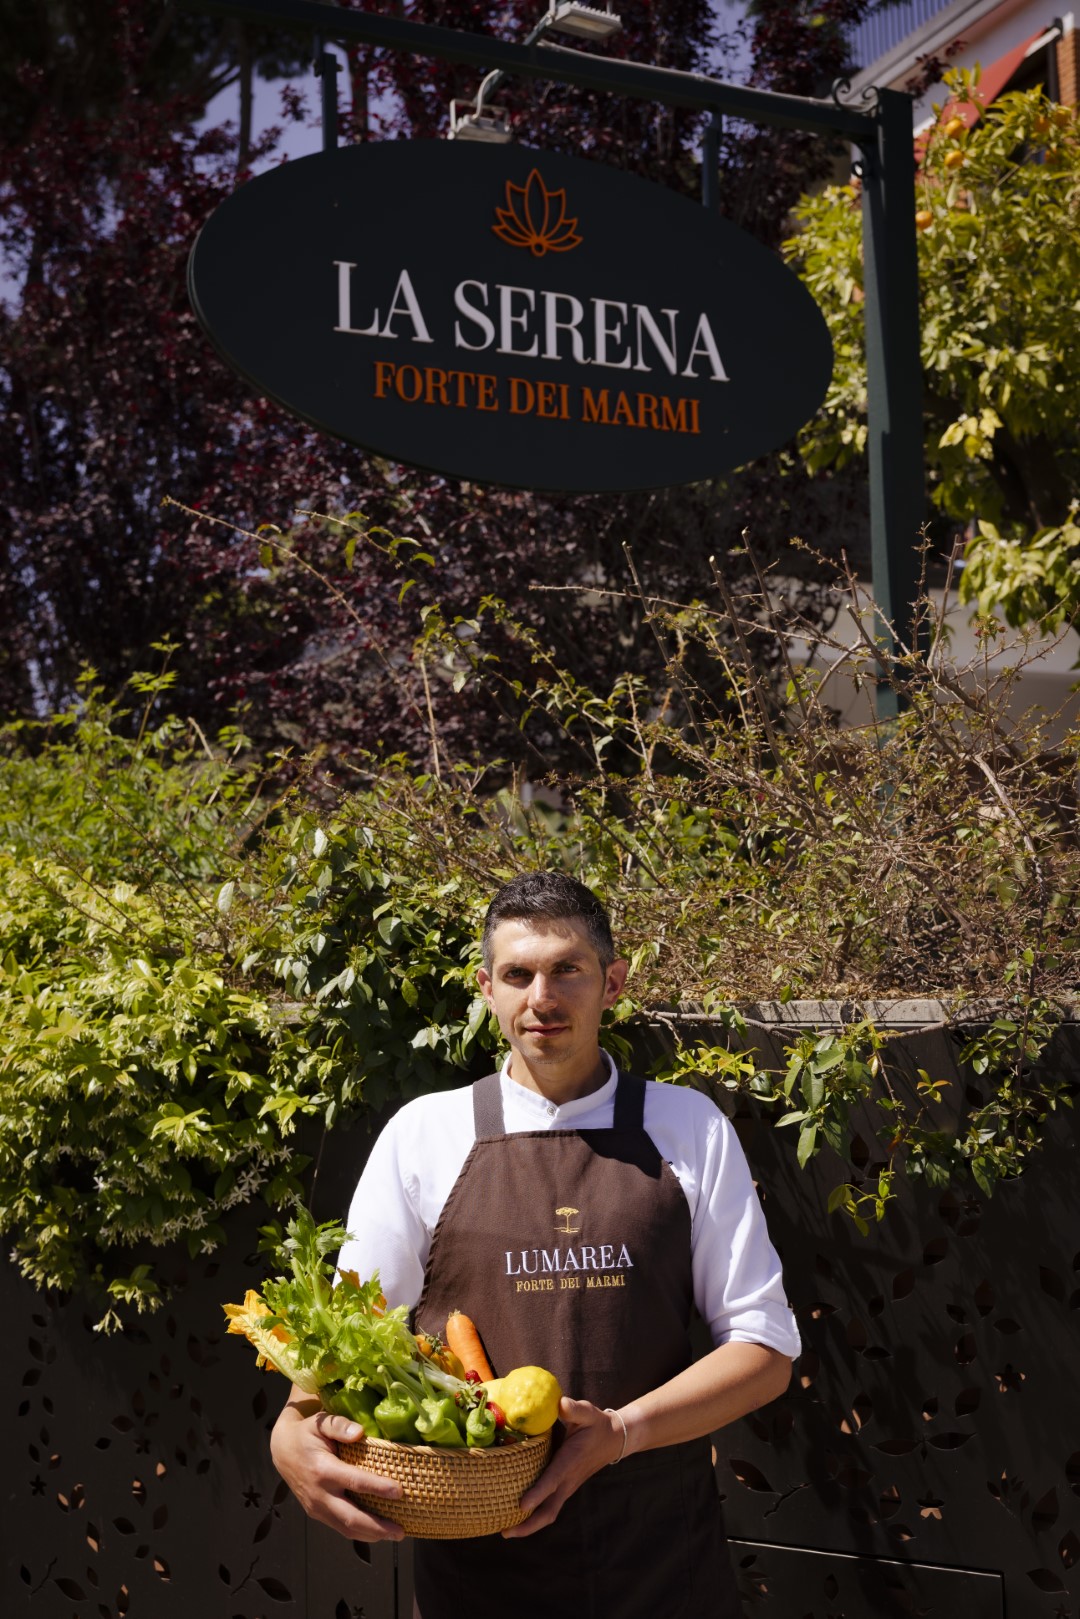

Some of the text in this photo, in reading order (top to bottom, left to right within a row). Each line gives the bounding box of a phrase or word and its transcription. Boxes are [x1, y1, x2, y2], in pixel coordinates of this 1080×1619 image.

[333, 260, 731, 382] LA SERENA
[373, 361, 701, 434] FORTE DEI MARMI
[505, 1243, 634, 1275] LUMAREA
[516, 1274, 625, 1292] FORTE DEI MARMI
